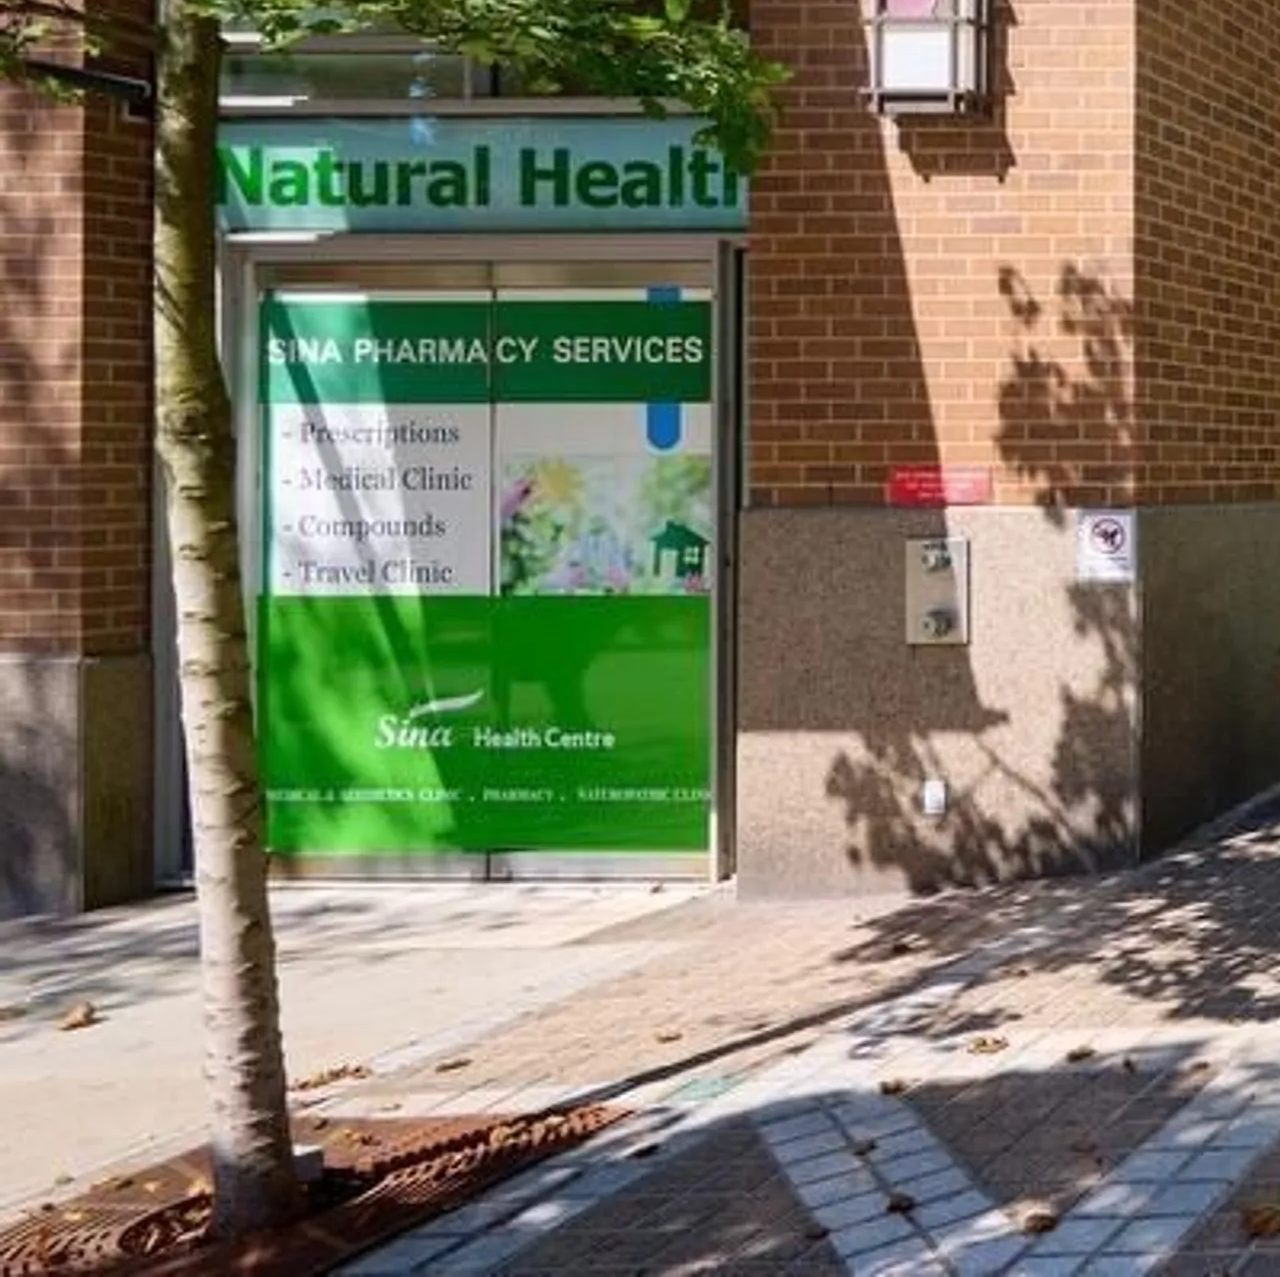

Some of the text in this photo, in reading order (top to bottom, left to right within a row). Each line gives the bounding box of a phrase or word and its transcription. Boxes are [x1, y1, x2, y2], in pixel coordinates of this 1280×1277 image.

[213, 145, 490, 208] Natural
[268, 337, 343, 364] SINA
[552, 336, 704, 364] SERVICES
[300, 420, 461, 449] Prescriptions
[300, 466, 473, 491] Medical Clinic
[299, 513, 448, 541] Compounds
[298, 559, 453, 584] Travel Clinic
[373, 714, 616, 748] Sina Health Centre
